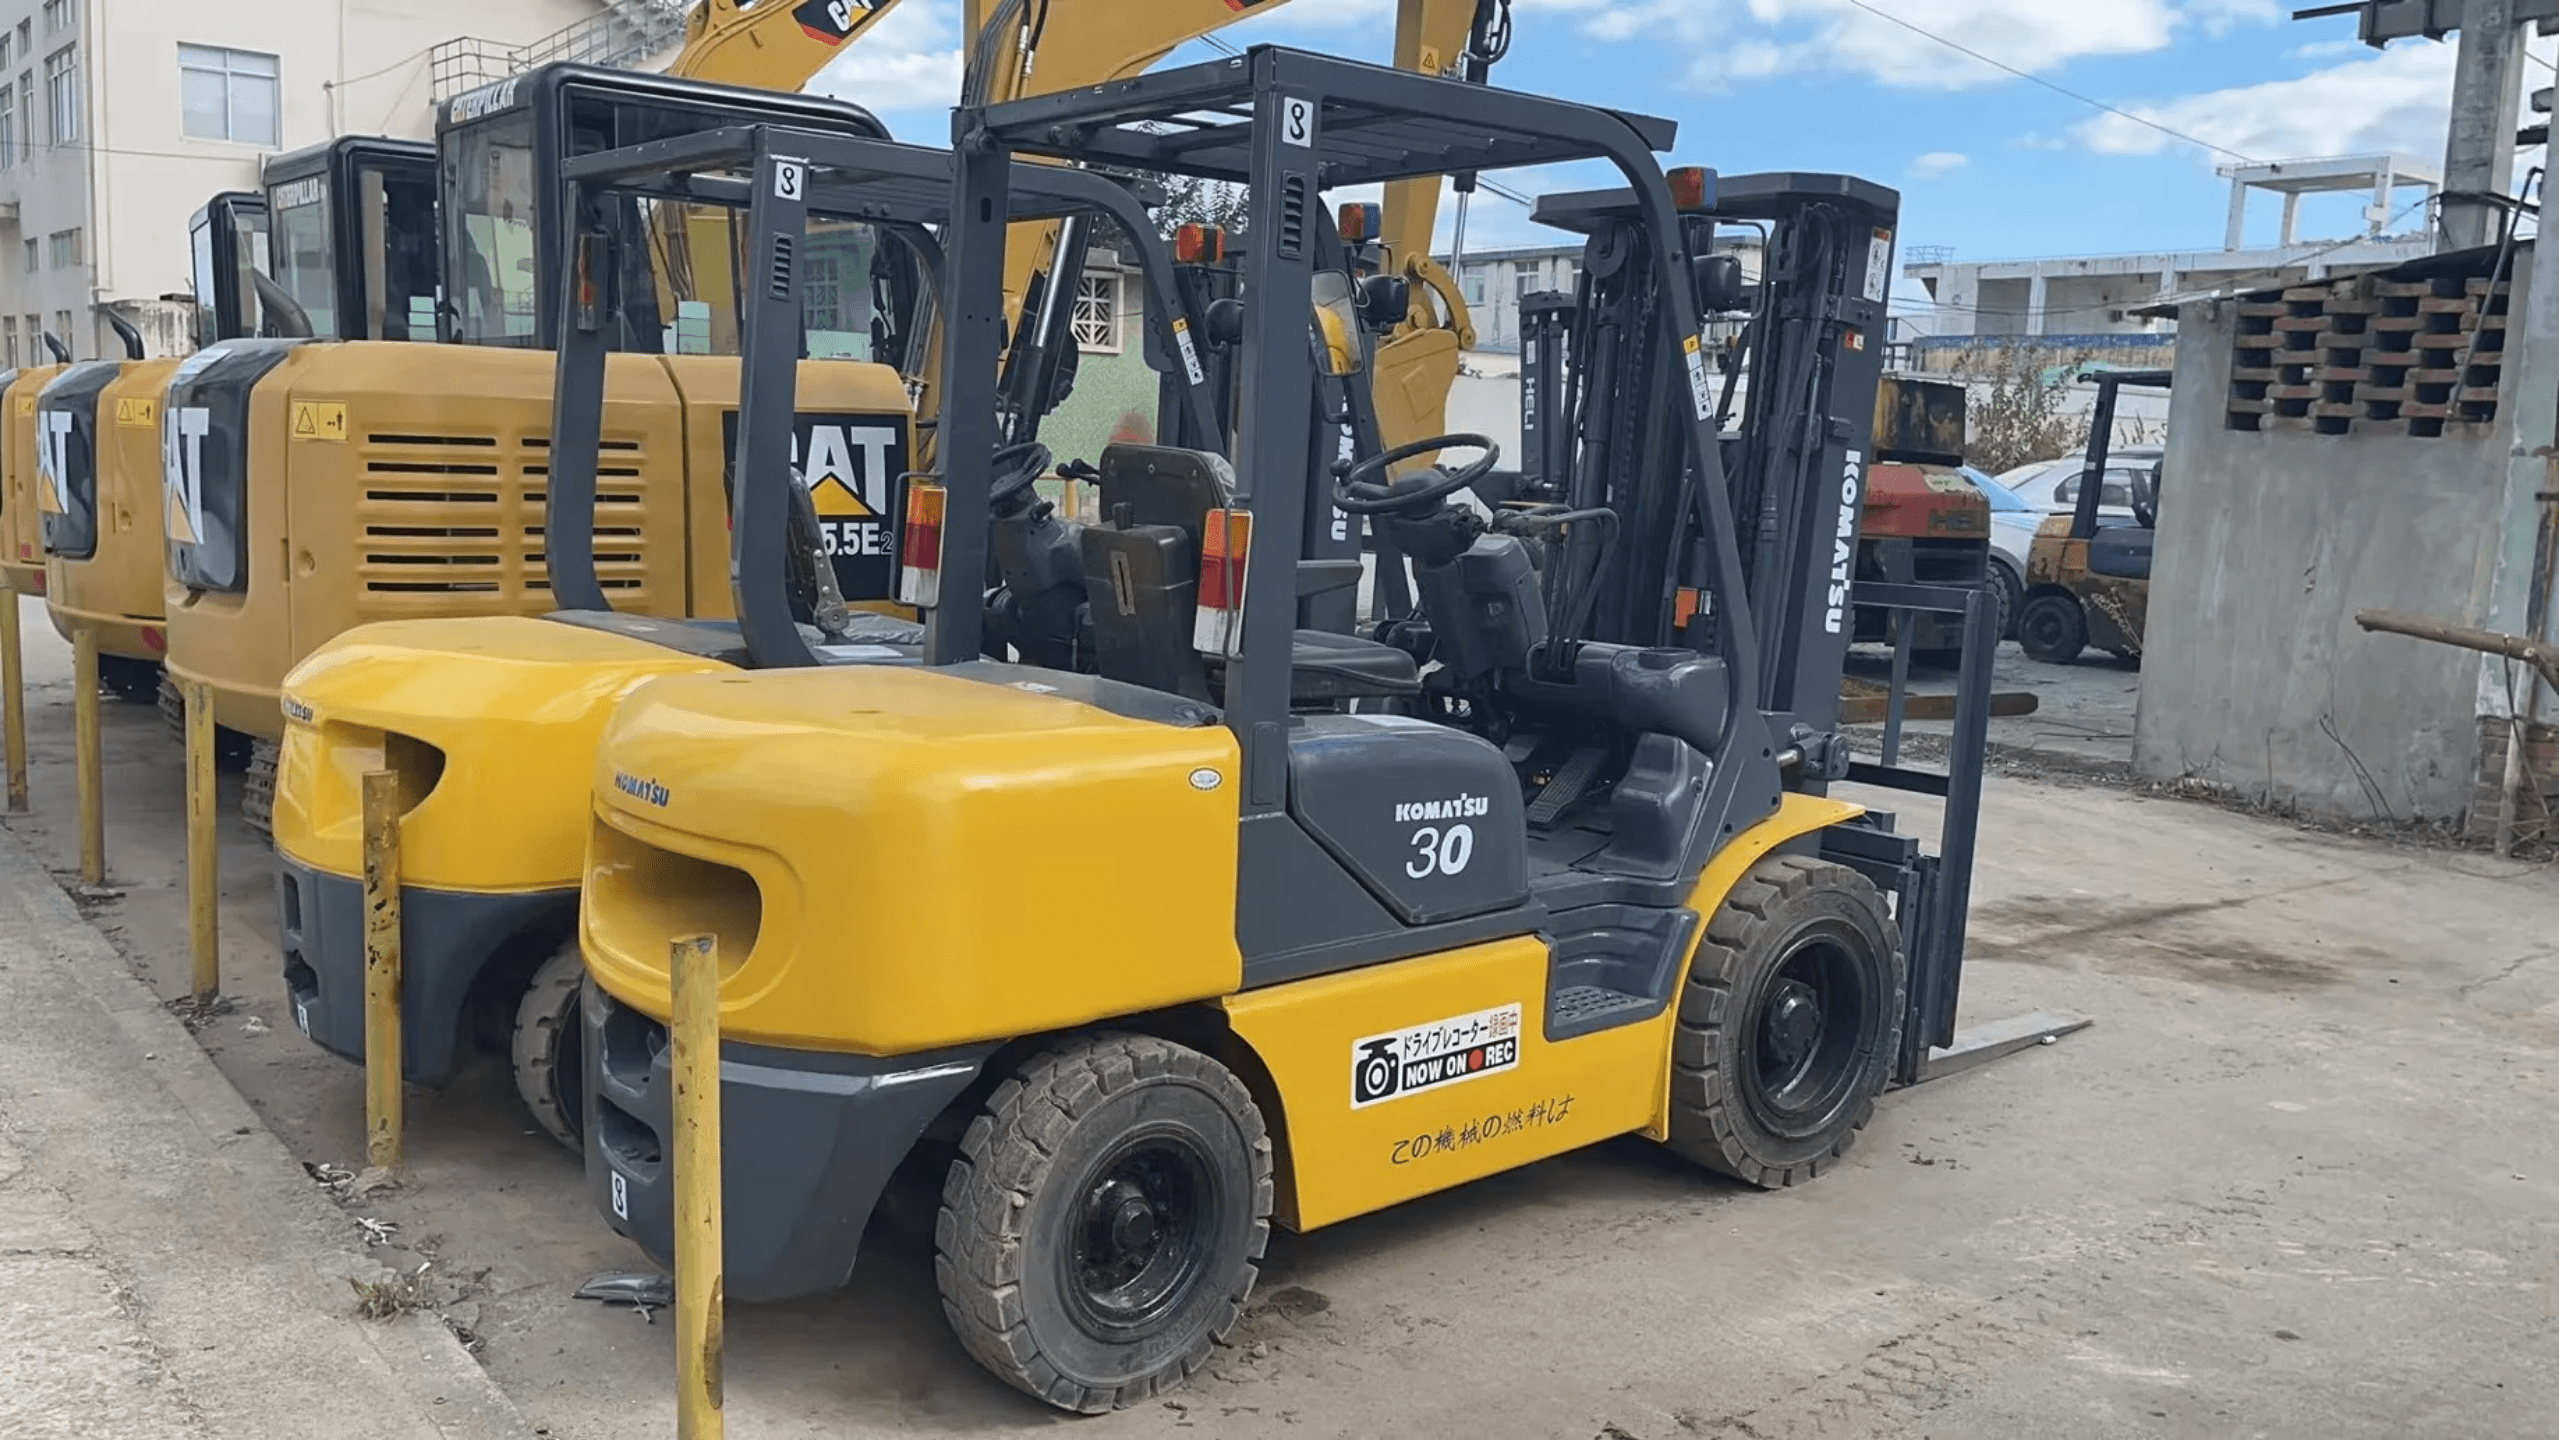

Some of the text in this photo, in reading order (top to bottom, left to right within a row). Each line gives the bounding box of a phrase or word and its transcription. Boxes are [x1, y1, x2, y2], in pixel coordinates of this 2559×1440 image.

[450, 79, 518, 123] CATERPILLAR
[1524, 377, 1535, 430] HELI
[790, 425, 896, 515] AT
[1825, 449, 1861, 634] KOMATSU
[615, 772, 670, 807] KOMATSU
[1395, 793, 1488, 821] KOMATSU
[1405, 823, 1474, 879] 30
[1405, 1040, 1514, 1089] NOW ON REC
[1391, 1095, 1575, 1165] この機械の燃料は
